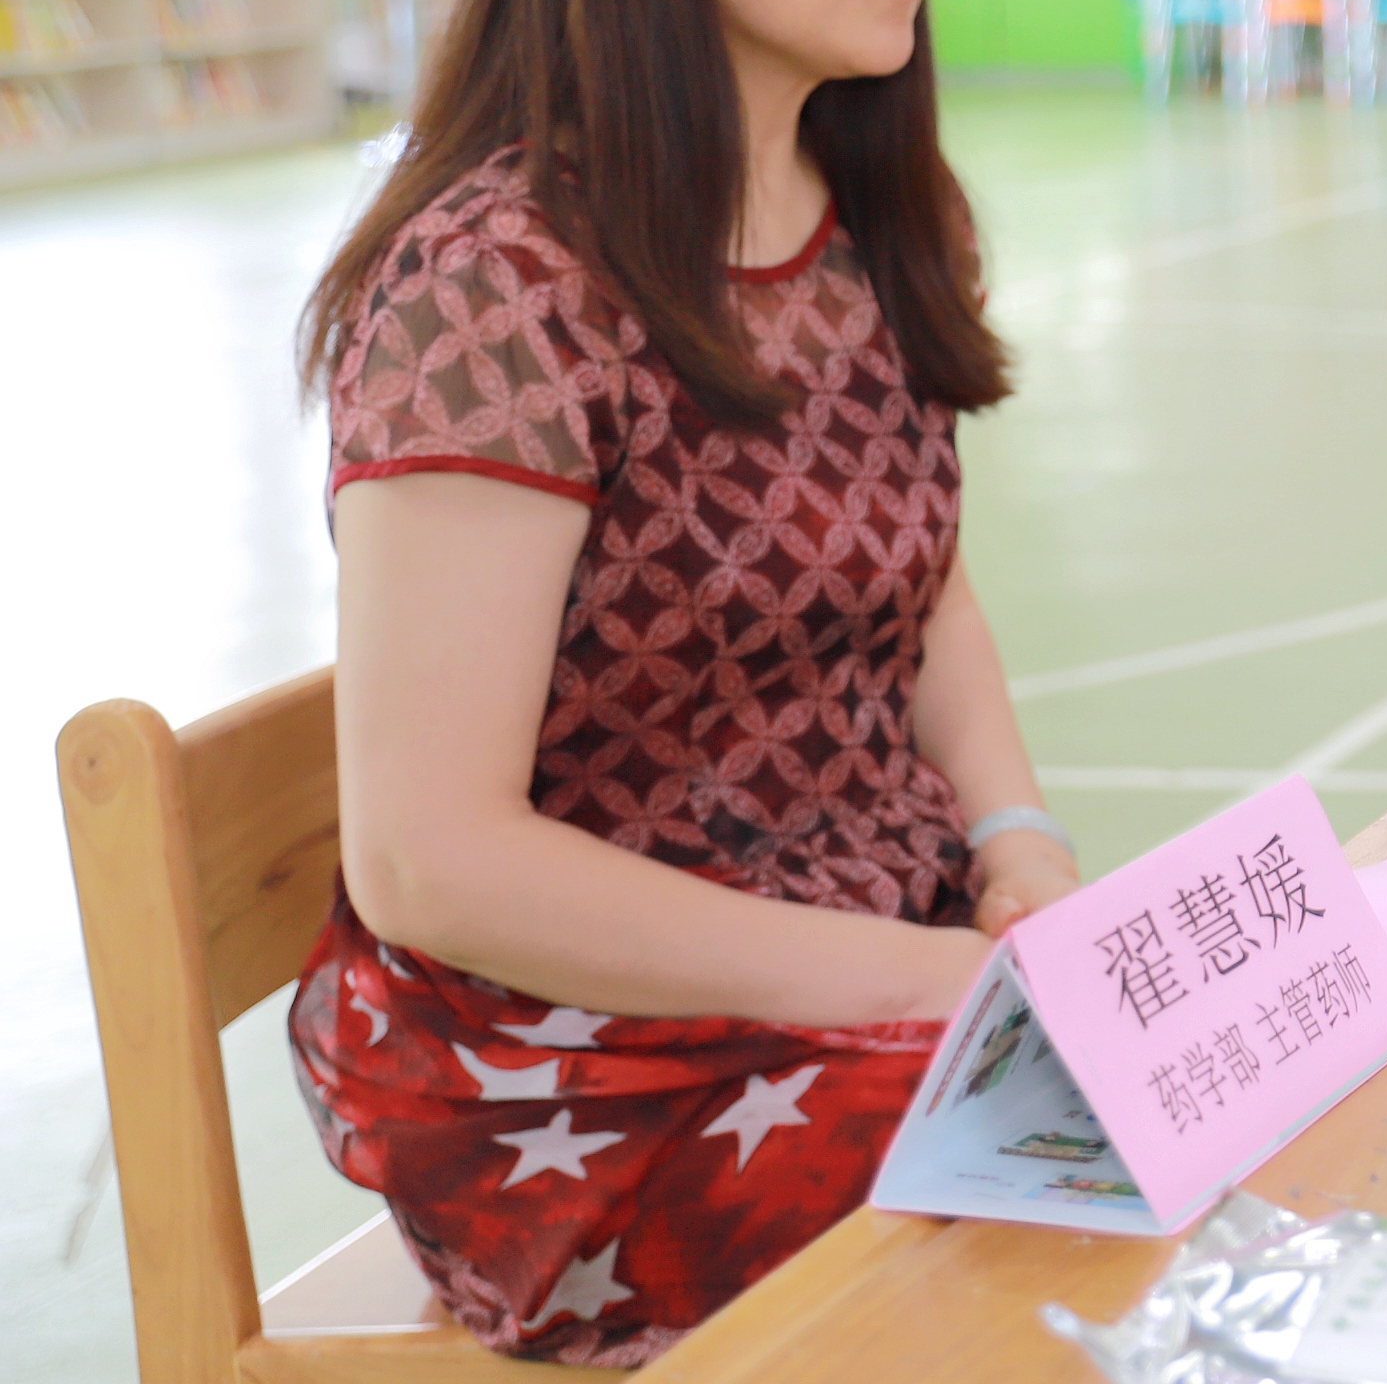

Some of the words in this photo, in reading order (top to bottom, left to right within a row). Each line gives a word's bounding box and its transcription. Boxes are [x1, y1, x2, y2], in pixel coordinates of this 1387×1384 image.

[1094, 833, 1326, 1029] 翟慧媛
[1146, 1024, 1261, 1135] 药学部
[1255, 944, 1373, 1067] 主管药师
